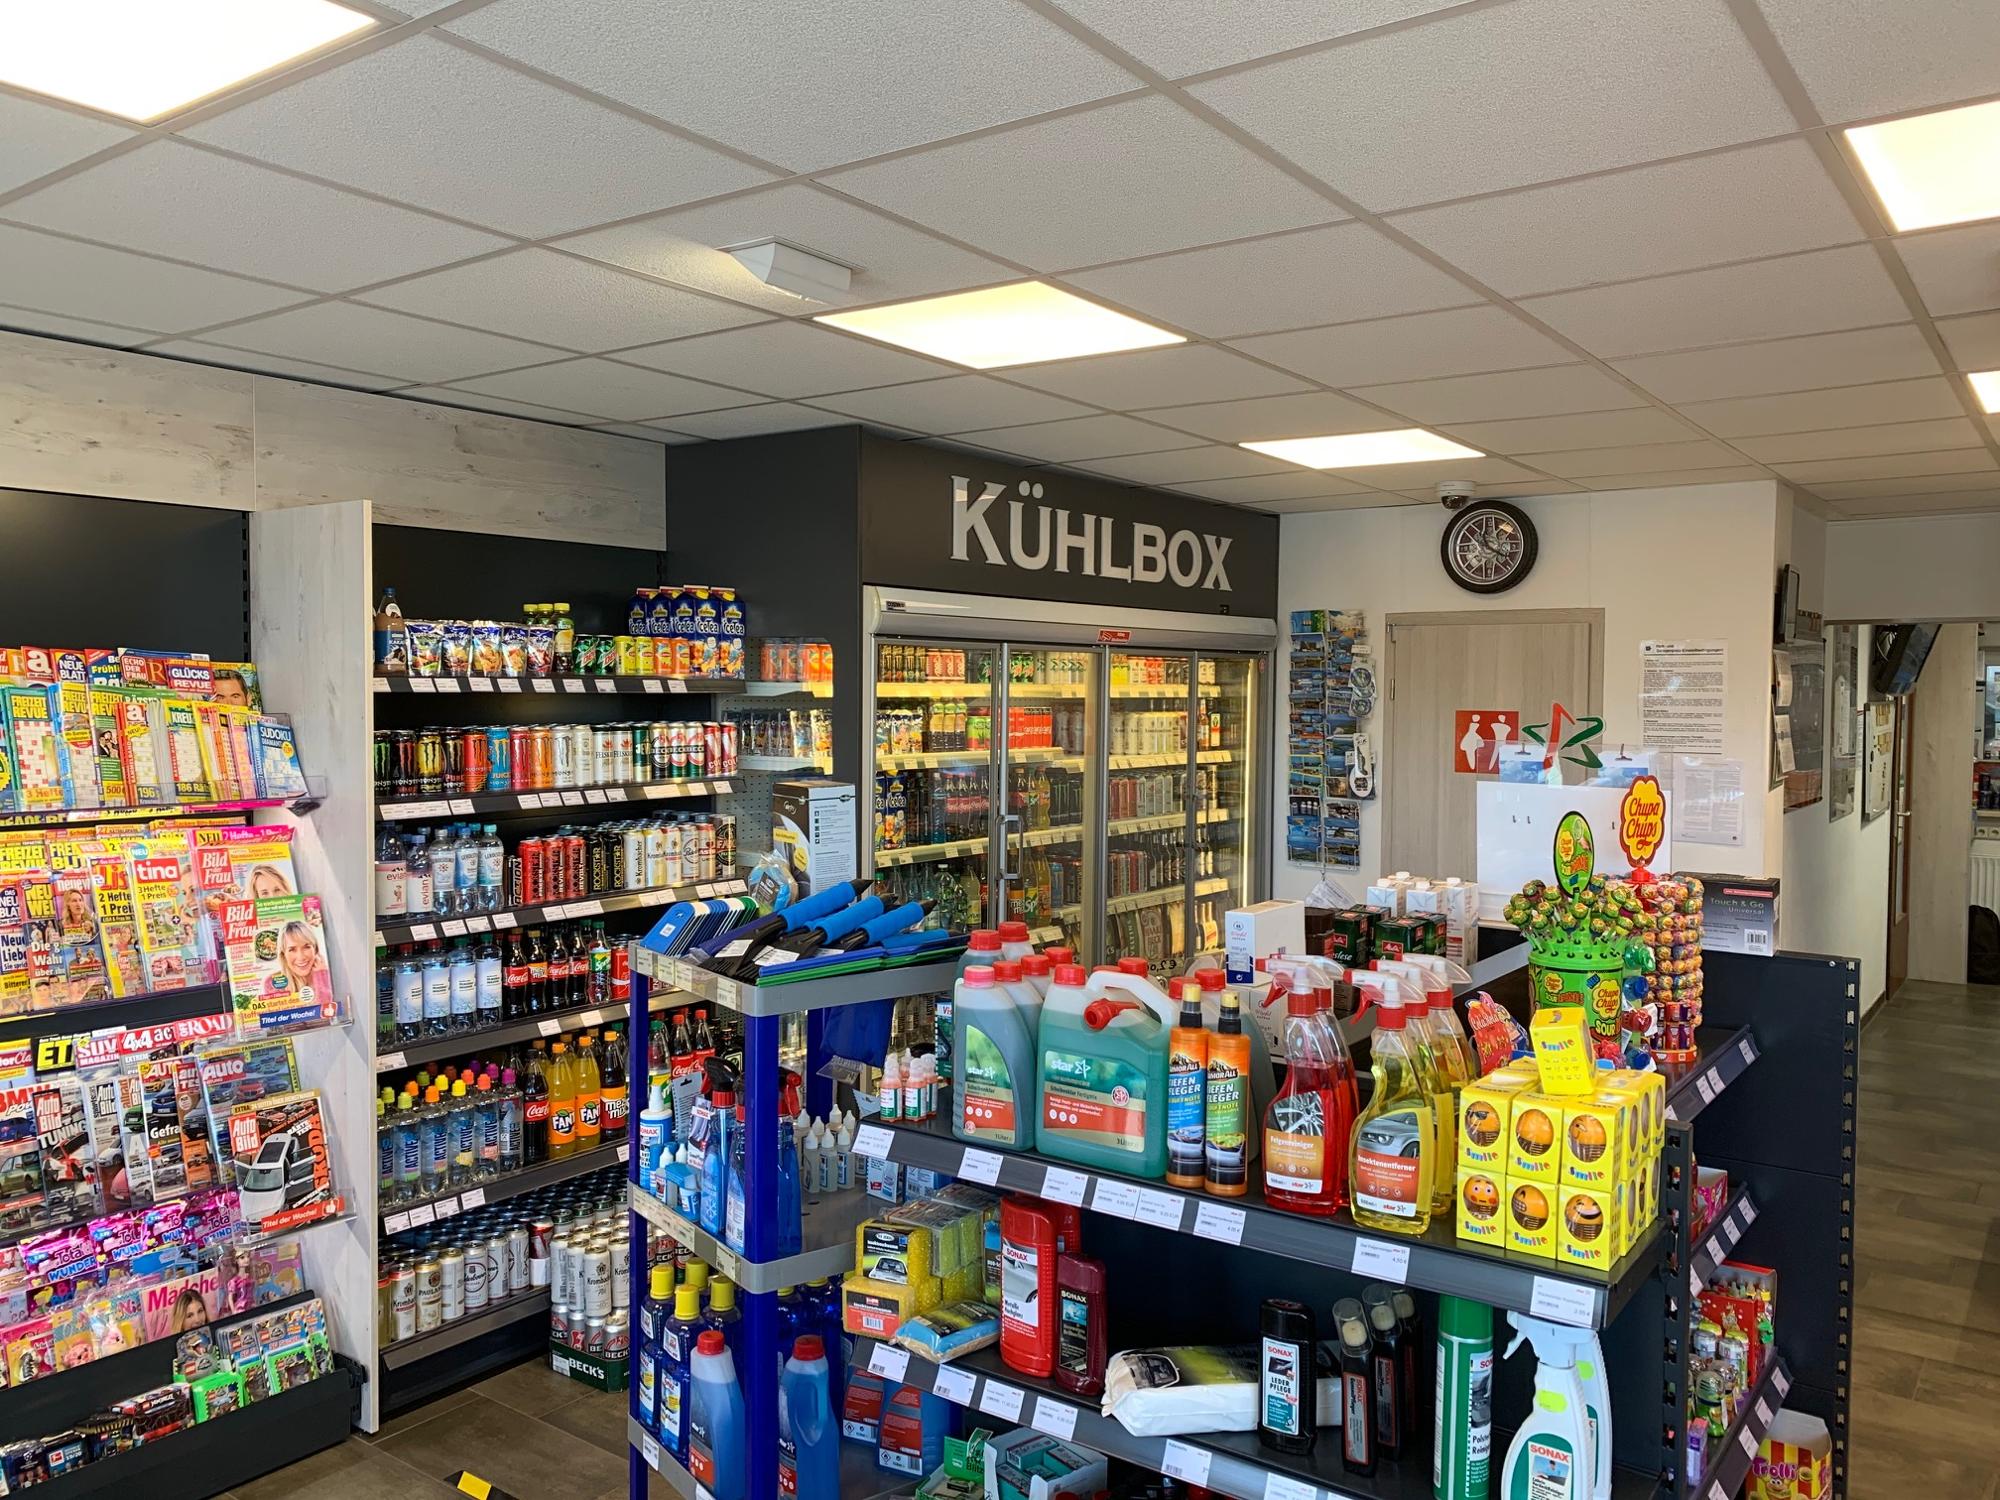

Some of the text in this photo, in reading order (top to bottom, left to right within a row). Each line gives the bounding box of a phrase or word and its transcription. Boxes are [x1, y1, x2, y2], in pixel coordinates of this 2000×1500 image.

[950, 475, 1233, 592] KÜHLBOX
[60, 660, 84, 671] NEUE
[124, 657, 144, 666] ECHO
[60, 670, 86, 681] BLATT
[125, 671, 147, 680] FRAU
[171, 667, 210, 680] GLÜCKS
[174, 679, 212, 690] REVUE
[11, 695, 46, 706] FREIZEIT
[14, 706, 48, 718] REVUE
[260, 728, 291, 741] SUDOKU
[176, 783, 192, 794] 186
[1629, 797, 1660, 817] Chupa
[1626, 818, 1658, 840] Chups
[203, 852, 228, 868] Bild
[636, 841, 645, 878] Krombacher
[136, 862, 177, 880] tina
[205, 869, 233, 884] Frau
[422, 879, 430, 905] evian
[1710, 897, 1738, 906] Touch
[1749, 900, 1764, 909] Go
[1728, 906, 1764, 915] Universal
[226, 903, 254, 922] Bild
[228, 924, 255, 939] Frau
[31, 941, 50, 952] Die
[1597, 988, 1619, 998] Chupa
[252, 1002, 266, 1011] DAS
[262, 1009, 316, 1024] Titel der Woche!
[188, 1014, 233, 1036] ROAD
[1595, 1018, 1616, 1037] SOUR
[78, 1038, 118, 1058] SUV
[122, 1030, 153, 1051] 4x4
[1051, 1059, 1074, 1072] star
[1225, 1068, 1238, 1078] ALL
[36, 1096, 60, 1117] Auto
[40, 1113, 62, 1134] Bild
[232, 1117, 256, 1138] Auto
[38, 1120, 86, 1149] TUNING
[235, 1132, 259, 1152] Bild
[460, 1120, 474, 1153] ACTIVE
[405, 1137, 419, 1169] ACTIVE
[433, 1131, 447, 1162] ACTIVE
[1357, 1154, 1416, 1172] Insektenentferner
[263, 1207, 318, 1228] Titel der Woche!
[1006, 1248, 1028, 1262] SONAX
[1061, 1290, 1087, 1304] SONAX
[1268, 1345, 1292, 1358] SONAX
[568, 1357, 605, 1380] BECK'S
[1270, 1383, 1292, 1395] PFLEGE
[1271, 1376, 1290, 1387] LEDER
[1530, 1444, 1569, 1463] SONAX
[1752, 1457, 1798, 1480] Trolli
